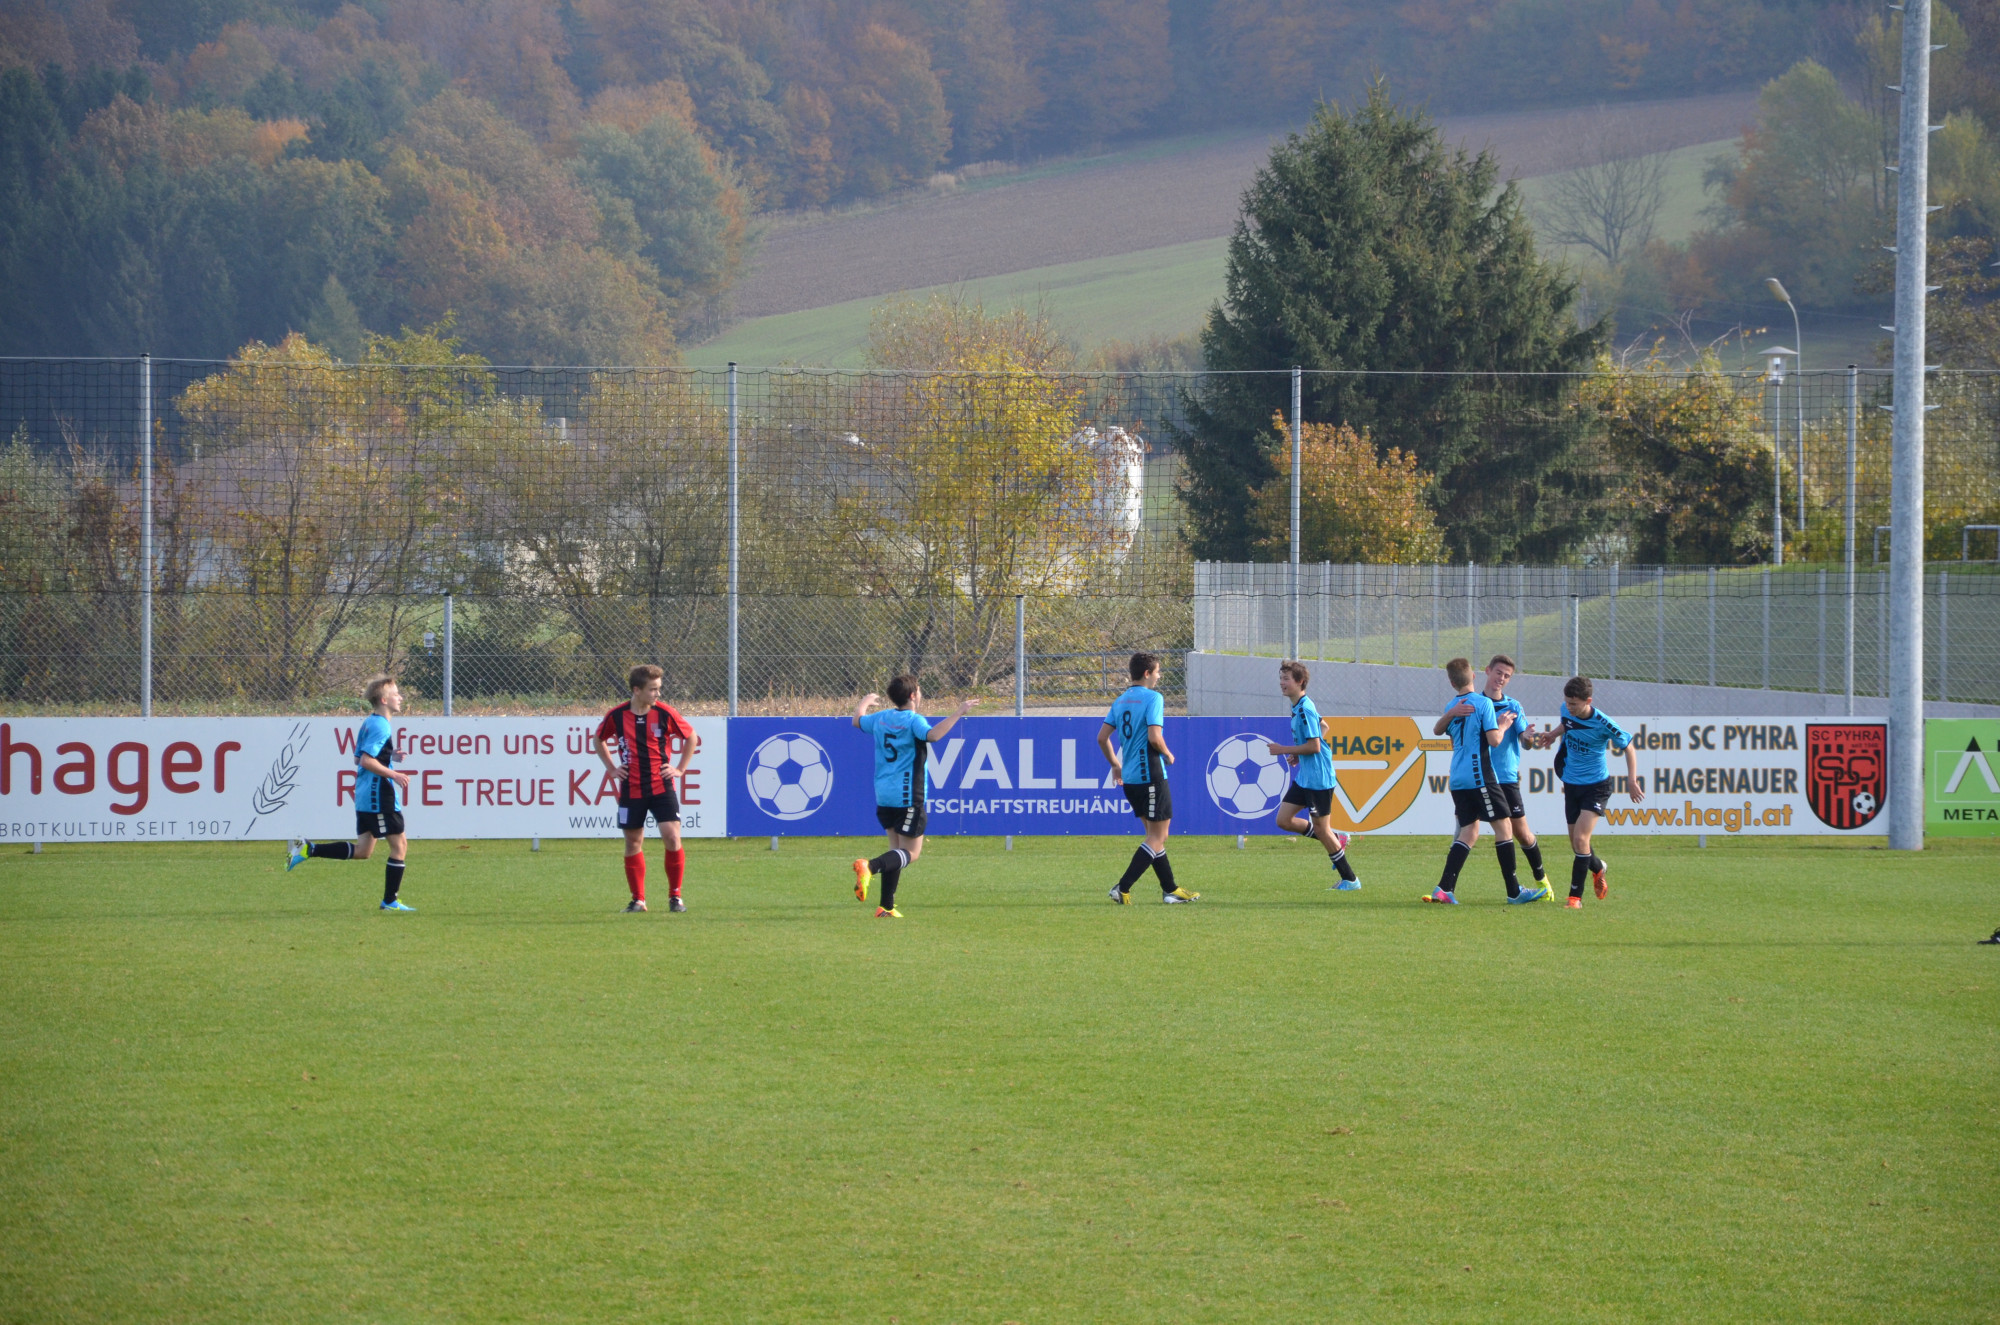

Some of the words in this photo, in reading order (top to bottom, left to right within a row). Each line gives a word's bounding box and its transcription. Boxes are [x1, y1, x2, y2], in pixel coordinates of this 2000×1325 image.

[1121, 710, 1133, 740] 8
[1632, 723, 1681, 750] dem
[1688, 725, 1715, 750] SC
[1723, 725, 1799, 750] PYHRA
[1811, 730, 1830, 741] SC
[1834, 730, 1881, 741] PYHRA
[396, 727, 491, 755] freuen
[504, 735, 554, 755] uns
[884, 733, 898, 763] 5
[0, 723, 242, 816] hager
[1654, 768, 1799, 794] HAGENAUER
[455, 779, 554, 806] TREUE
[0, 822, 126, 837] BROTKULTUR
[136, 821, 178, 836] SEIT
[188, 820, 231, 835] 1907
[1605, 800, 1793, 832] www.hagi.at
